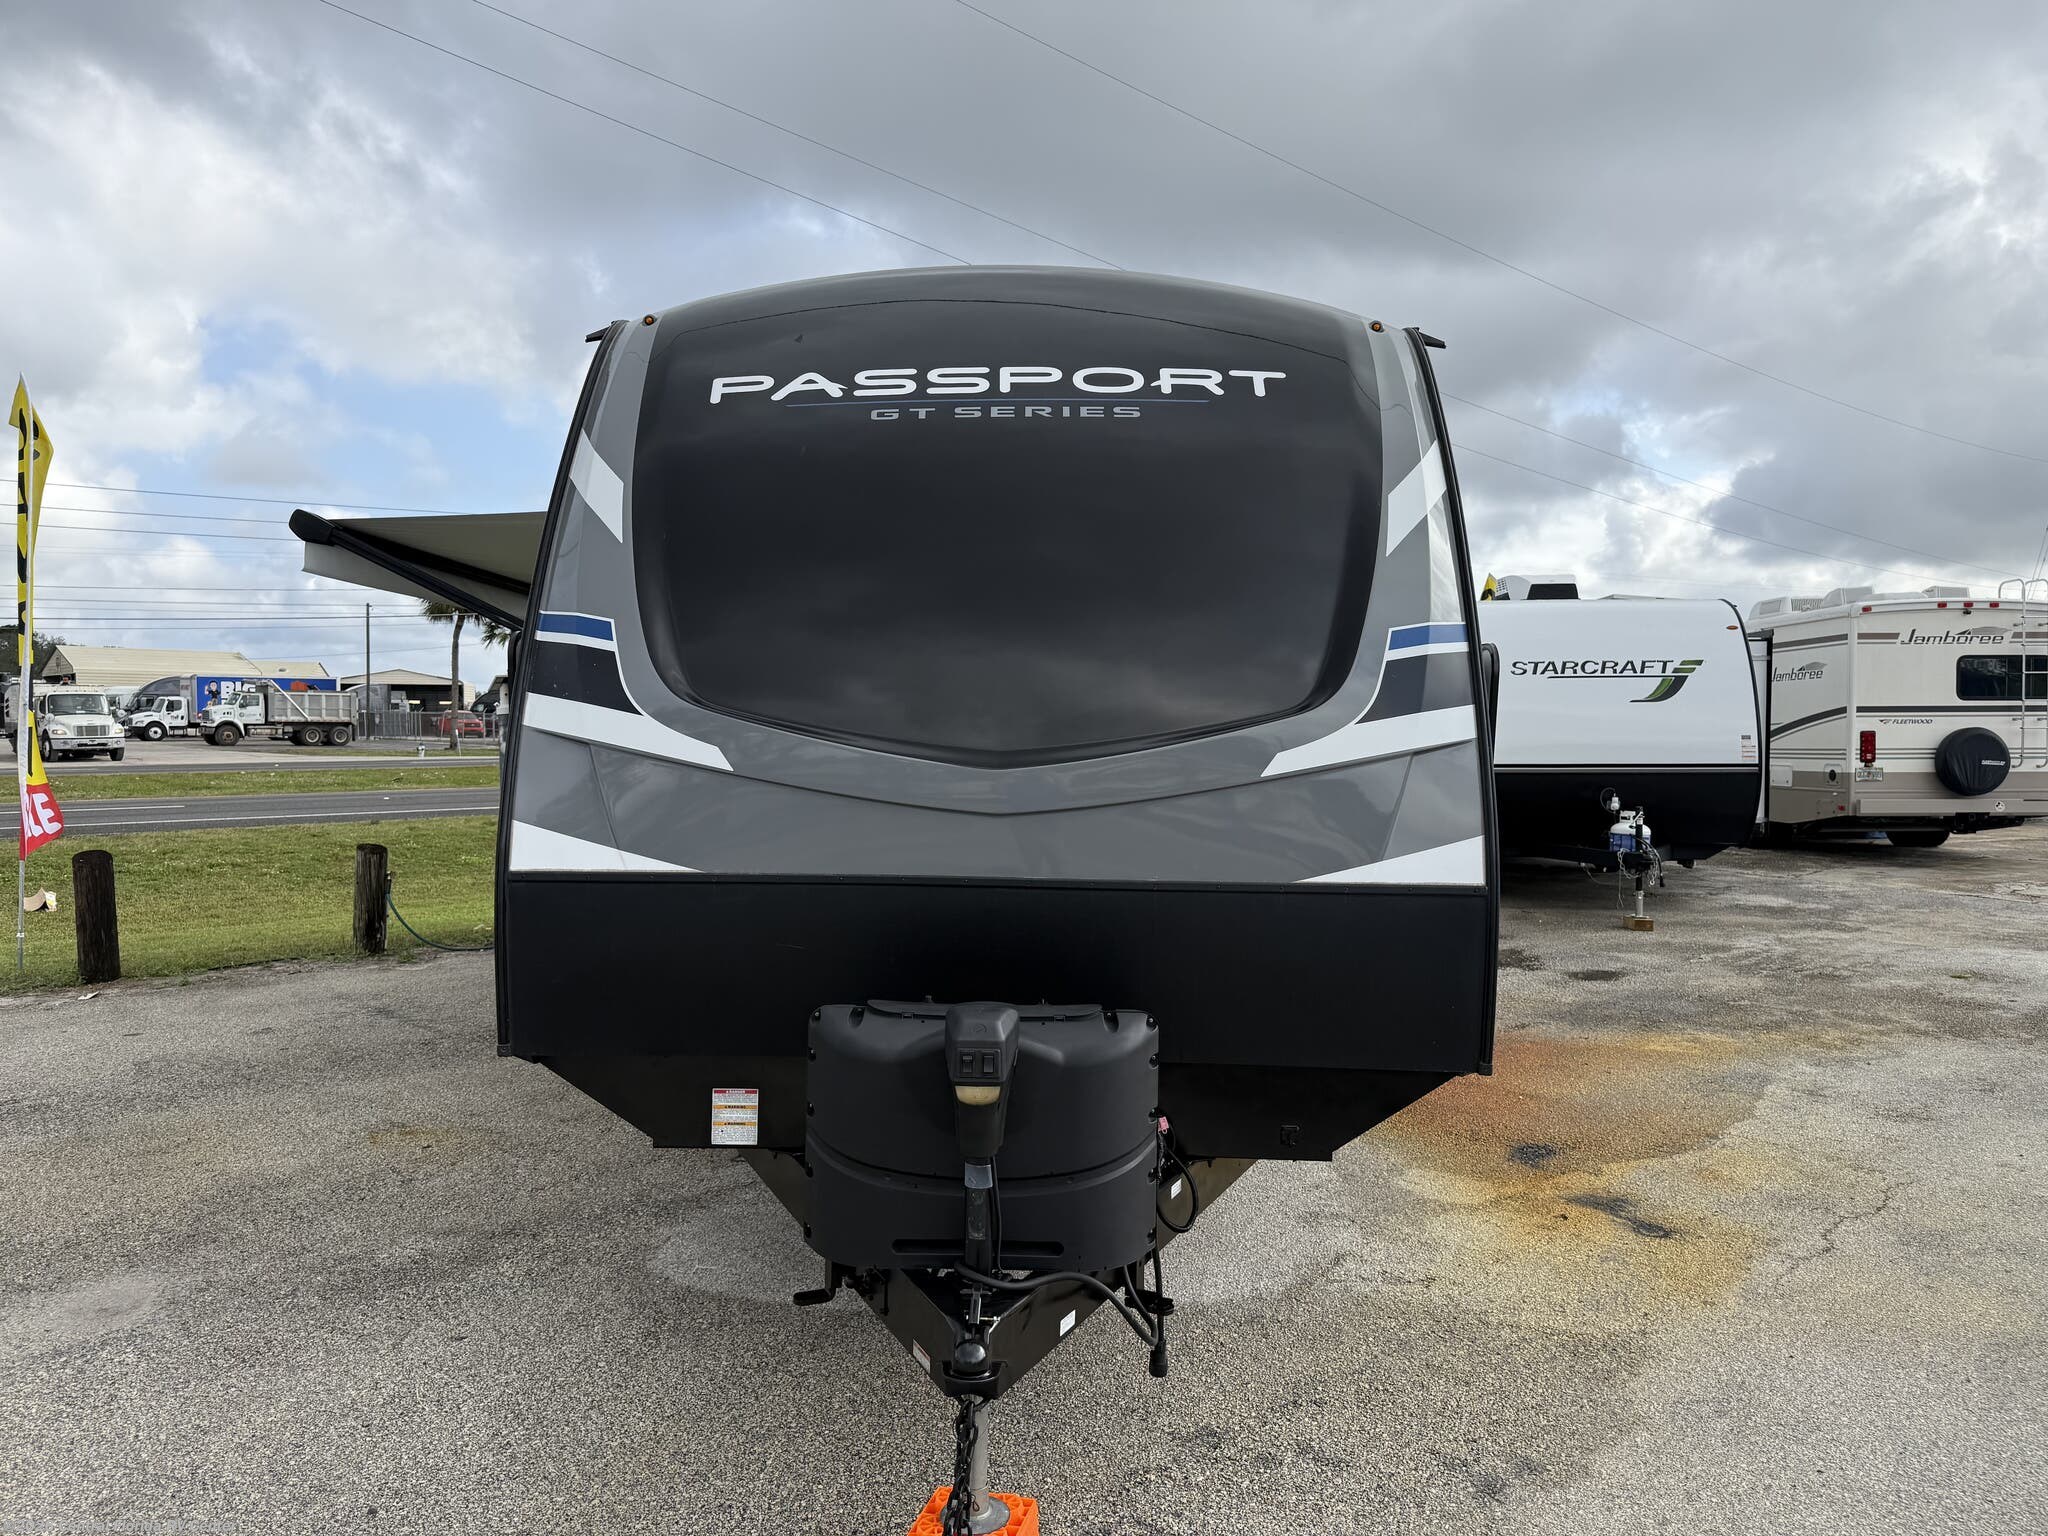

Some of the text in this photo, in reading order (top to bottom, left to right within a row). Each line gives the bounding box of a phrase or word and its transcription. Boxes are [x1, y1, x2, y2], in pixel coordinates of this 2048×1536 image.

[709, 366, 1287, 404] PASSPORT
[870, 405, 1141, 421] GT SERIES
[1900, 628, 2005, 645] Jamboree
[1510, 659, 1675, 676] STARCRAFT
[1772, 666, 1824, 682] Jamboree
